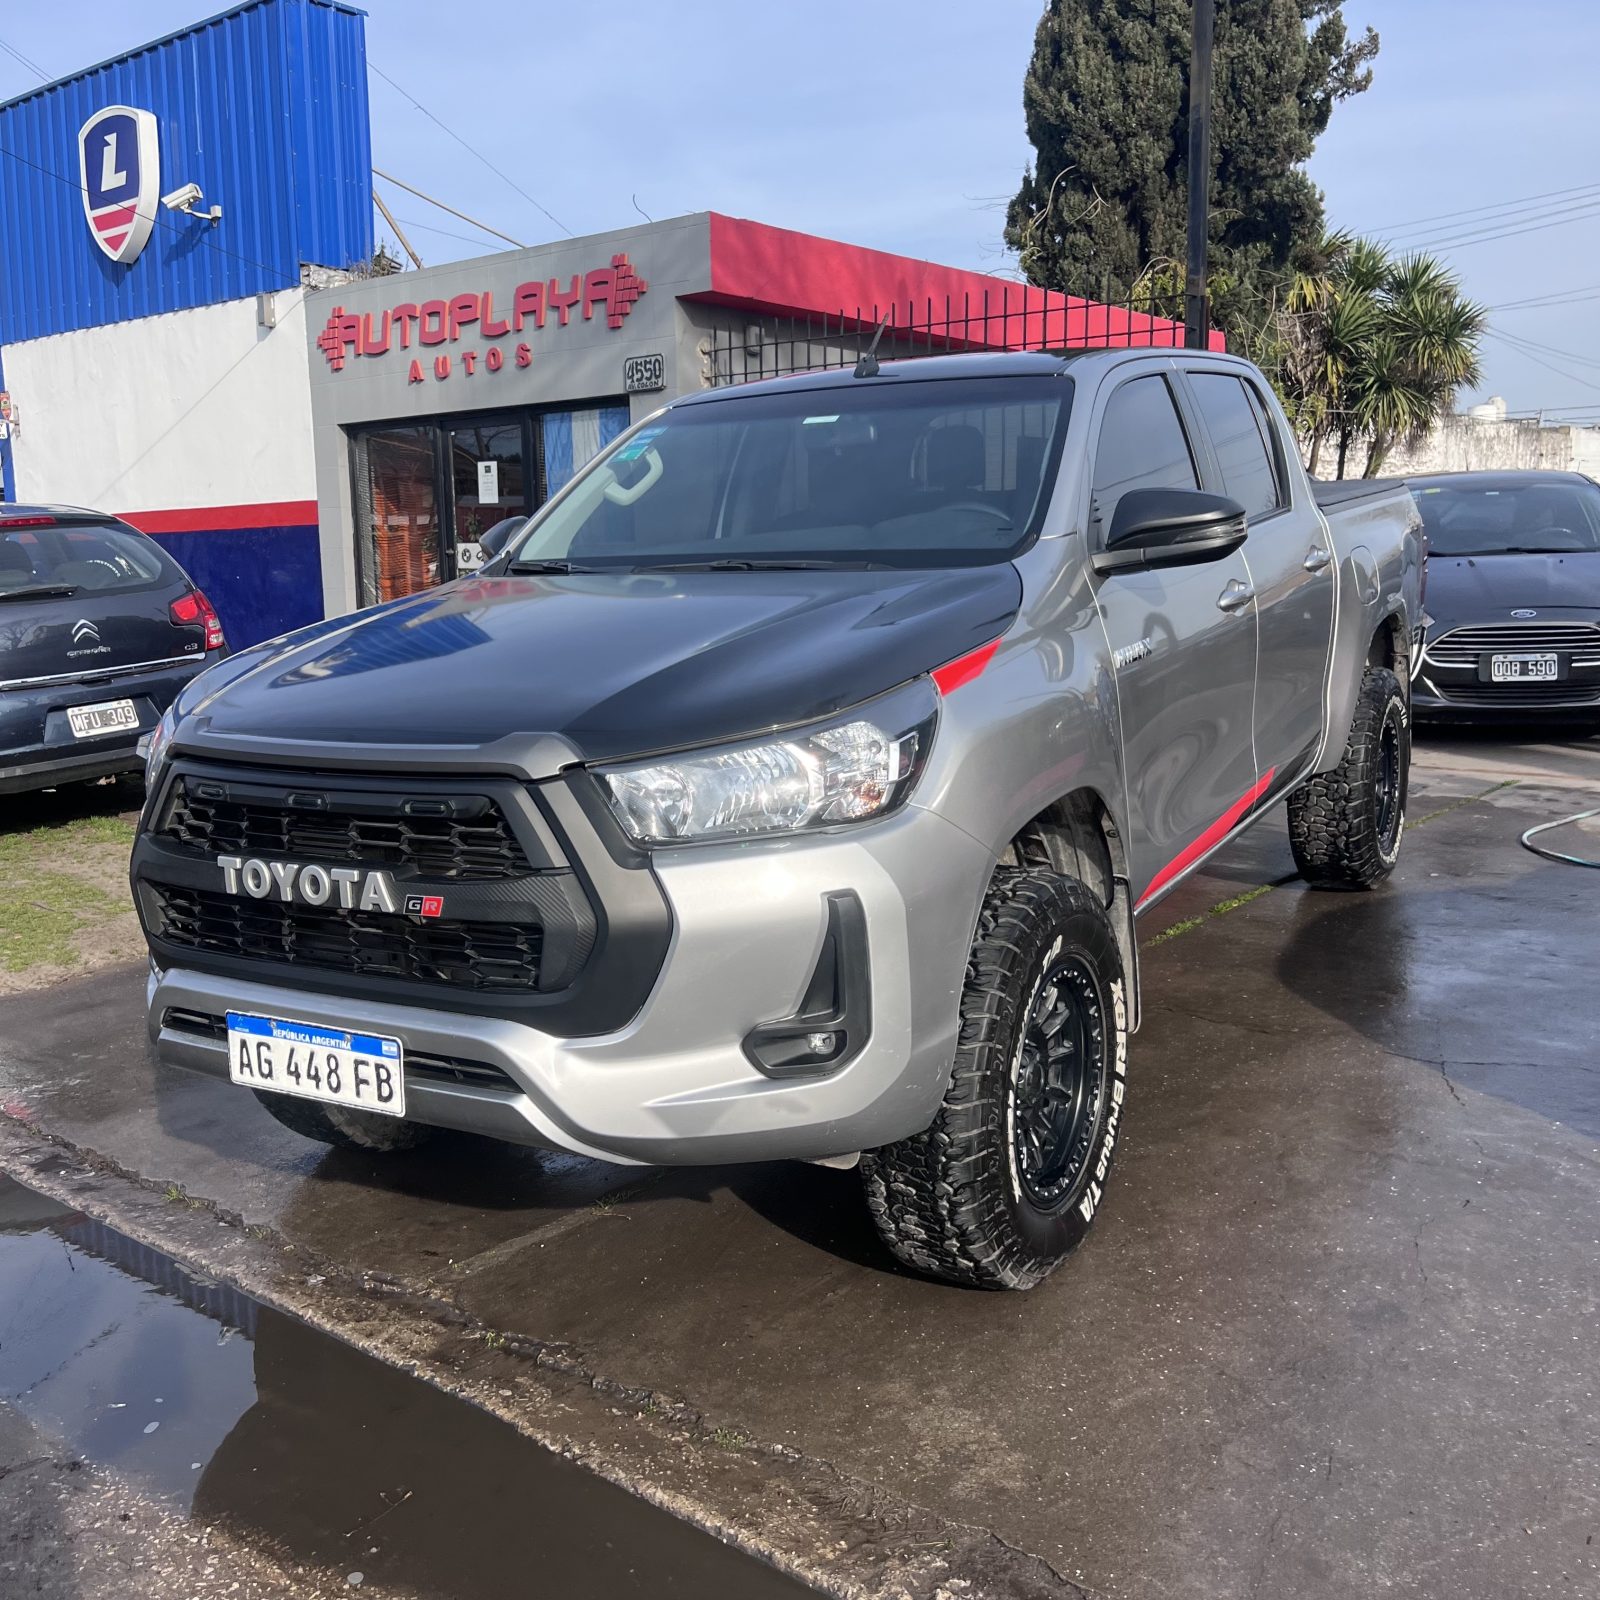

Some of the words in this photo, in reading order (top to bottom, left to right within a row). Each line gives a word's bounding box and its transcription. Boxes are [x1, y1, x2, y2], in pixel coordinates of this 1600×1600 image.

[335, 268, 617, 356] AUTOPLAYA
[408, 343, 533, 383] AUTOS
[626, 358, 662, 383] 4550
[1528, 660, 1555, 676] 590
[71, 712, 102, 732] MFU
[106, 706, 135, 725] 349
[217, 855, 396, 913] TOYOTA
[407, 898, 440, 913] GR
[272, 1027, 311, 1043] REPÚBLICA
[312, 1034, 352, 1051] ARGENTINA
[239, 1038, 274, 1081] AG
[286, 1046, 342, 1094] 448
[353, 1058, 394, 1103] FB
